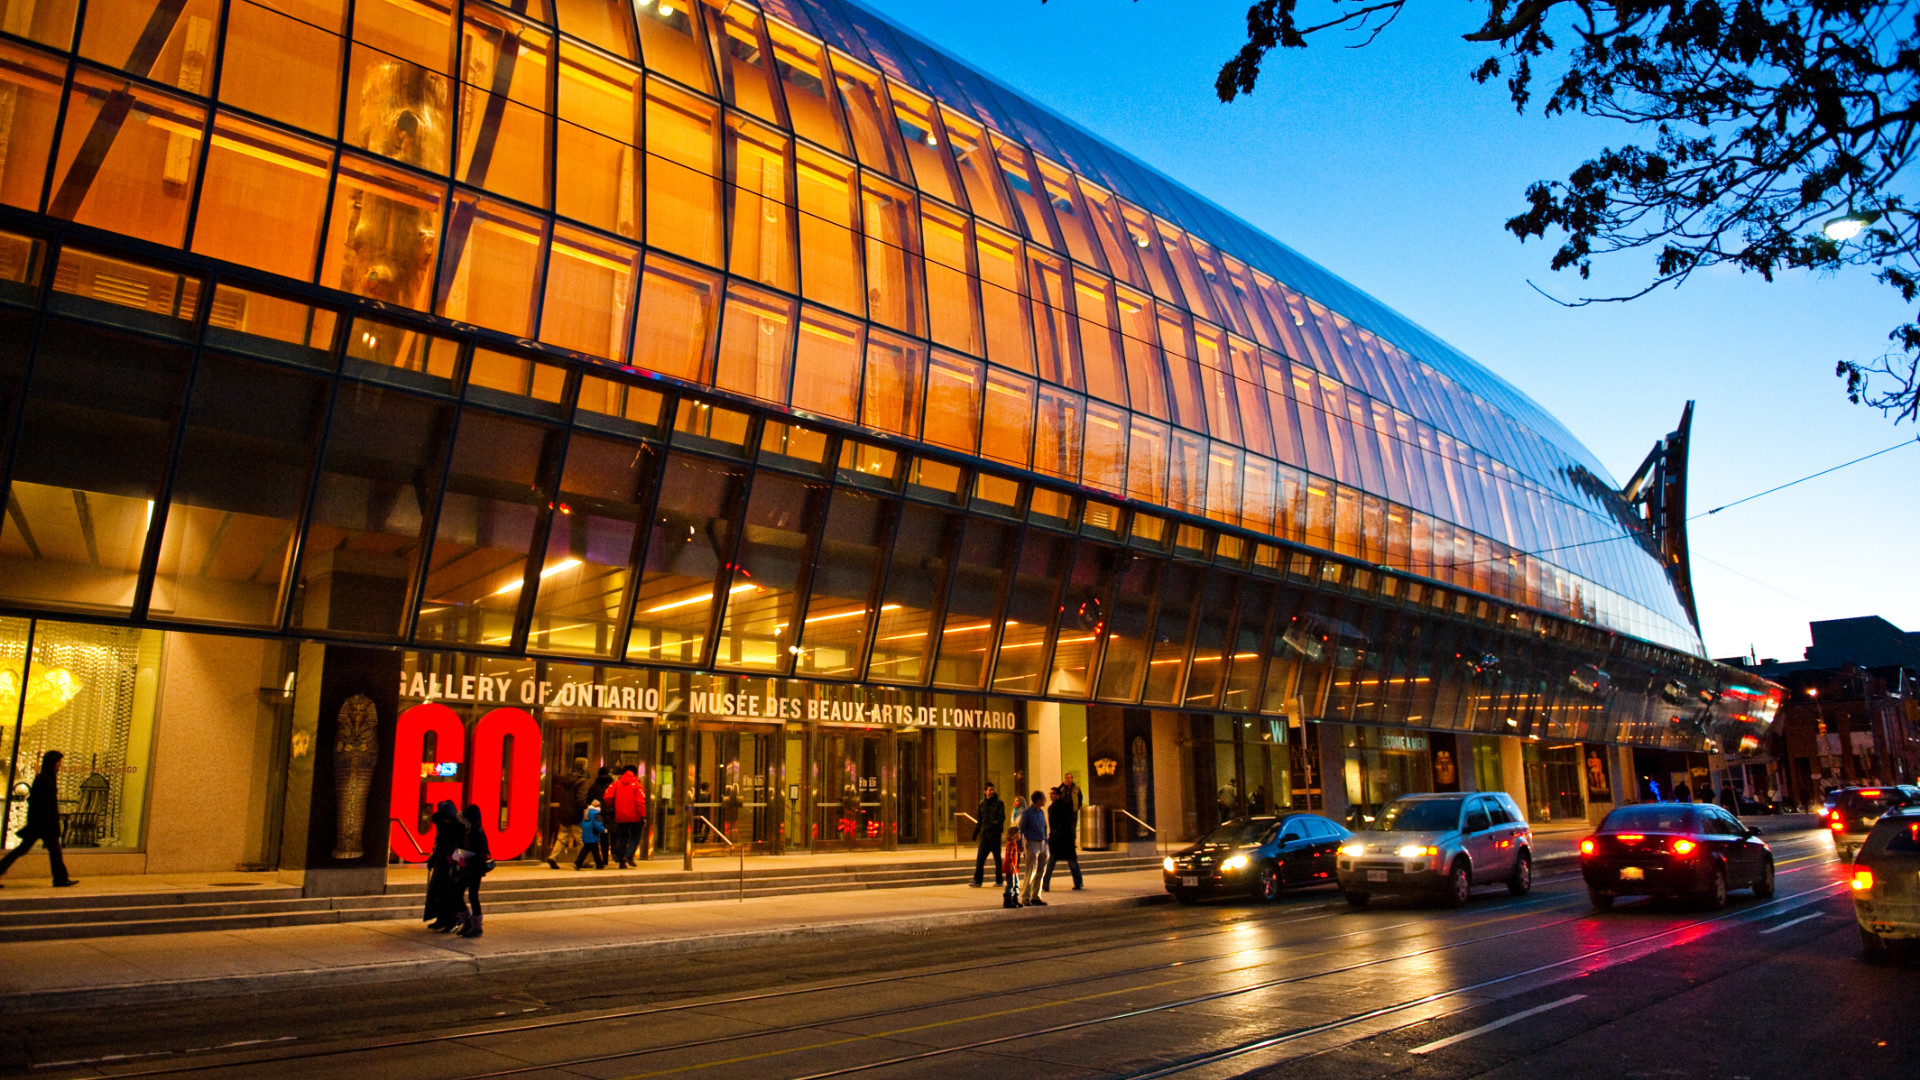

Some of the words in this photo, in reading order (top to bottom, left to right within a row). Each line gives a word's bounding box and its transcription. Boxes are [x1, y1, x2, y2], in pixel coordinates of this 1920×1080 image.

[520, 679, 552, 705] OF
[561, 682, 660, 712] ONTARIO
[689, 689, 760, 717] MUSÉE
[766, 697, 801, 720] DES
[807, 698, 914, 726] BEAUX-ARTS
[917, 706, 938, 726] DE
[942, 707, 1016, 731] L'ONTARIO
